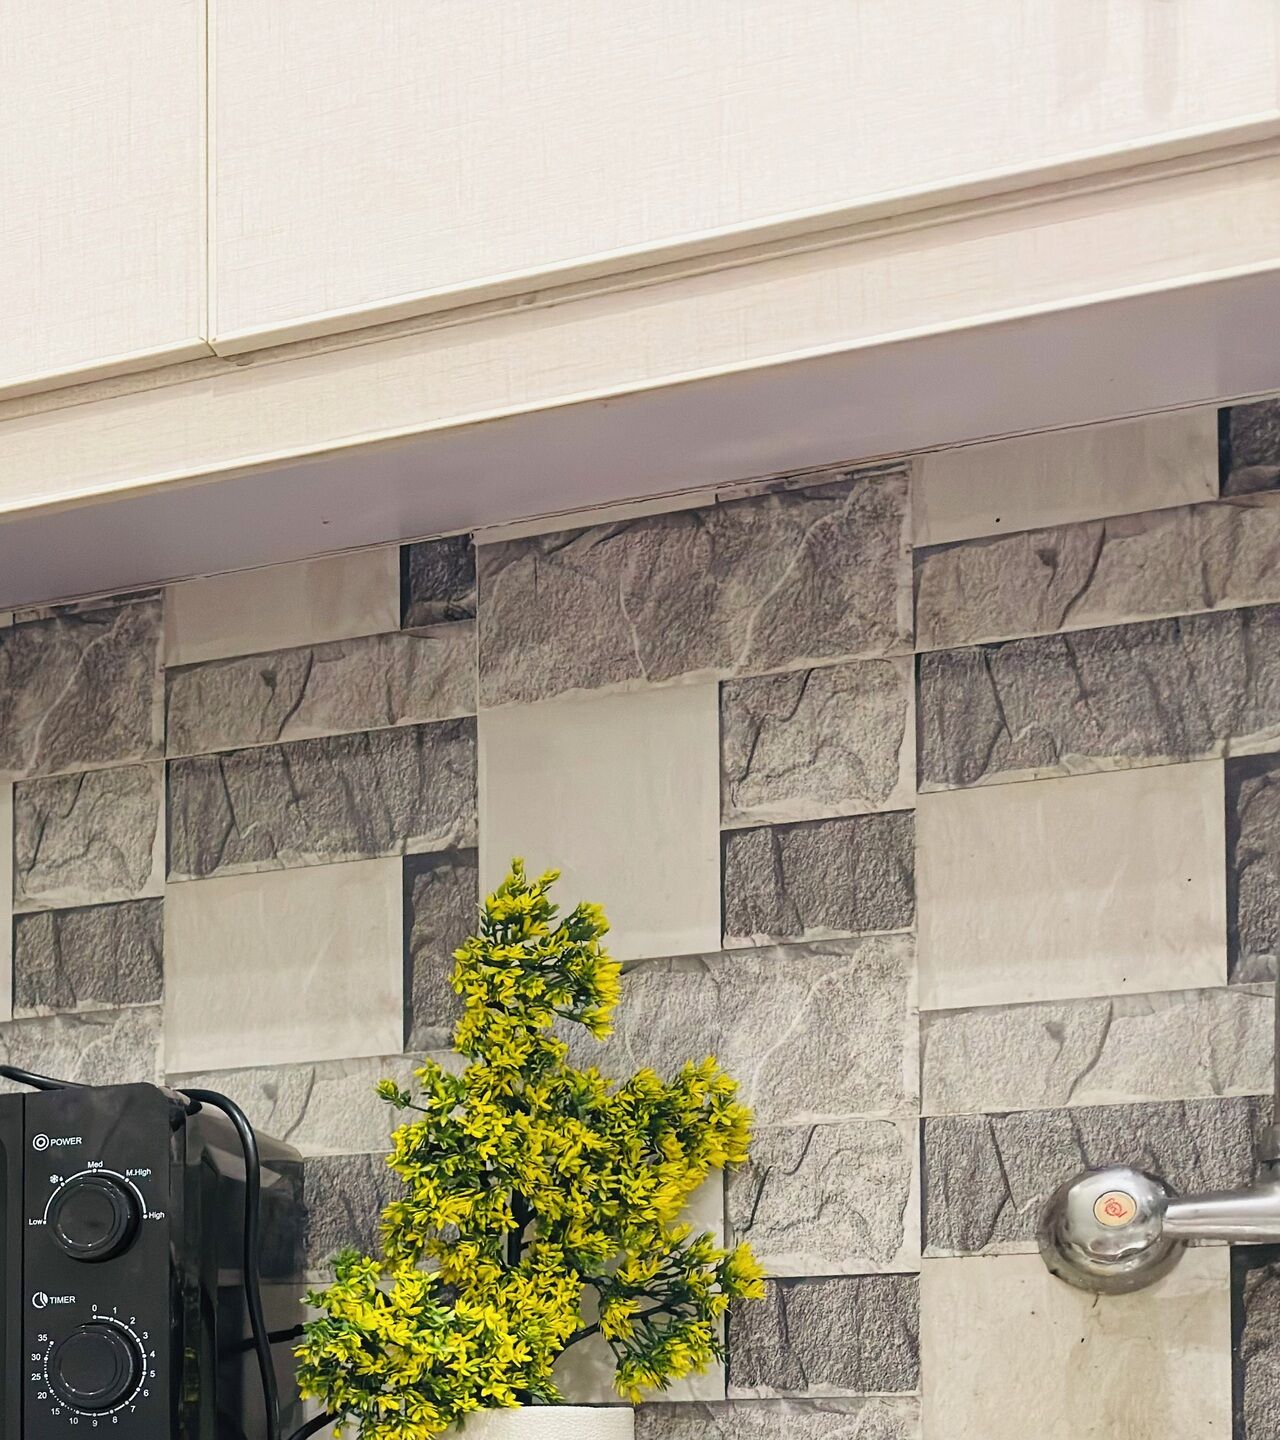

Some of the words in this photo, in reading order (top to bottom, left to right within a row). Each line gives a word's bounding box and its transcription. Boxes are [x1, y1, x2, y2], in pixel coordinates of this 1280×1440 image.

[50, 1136, 82, 1146] POWER
[126, 1168, 152, 1176] M.High
[148, 1212, 164, 1220] High
[50, 1296, 76, 1304] TIMER
